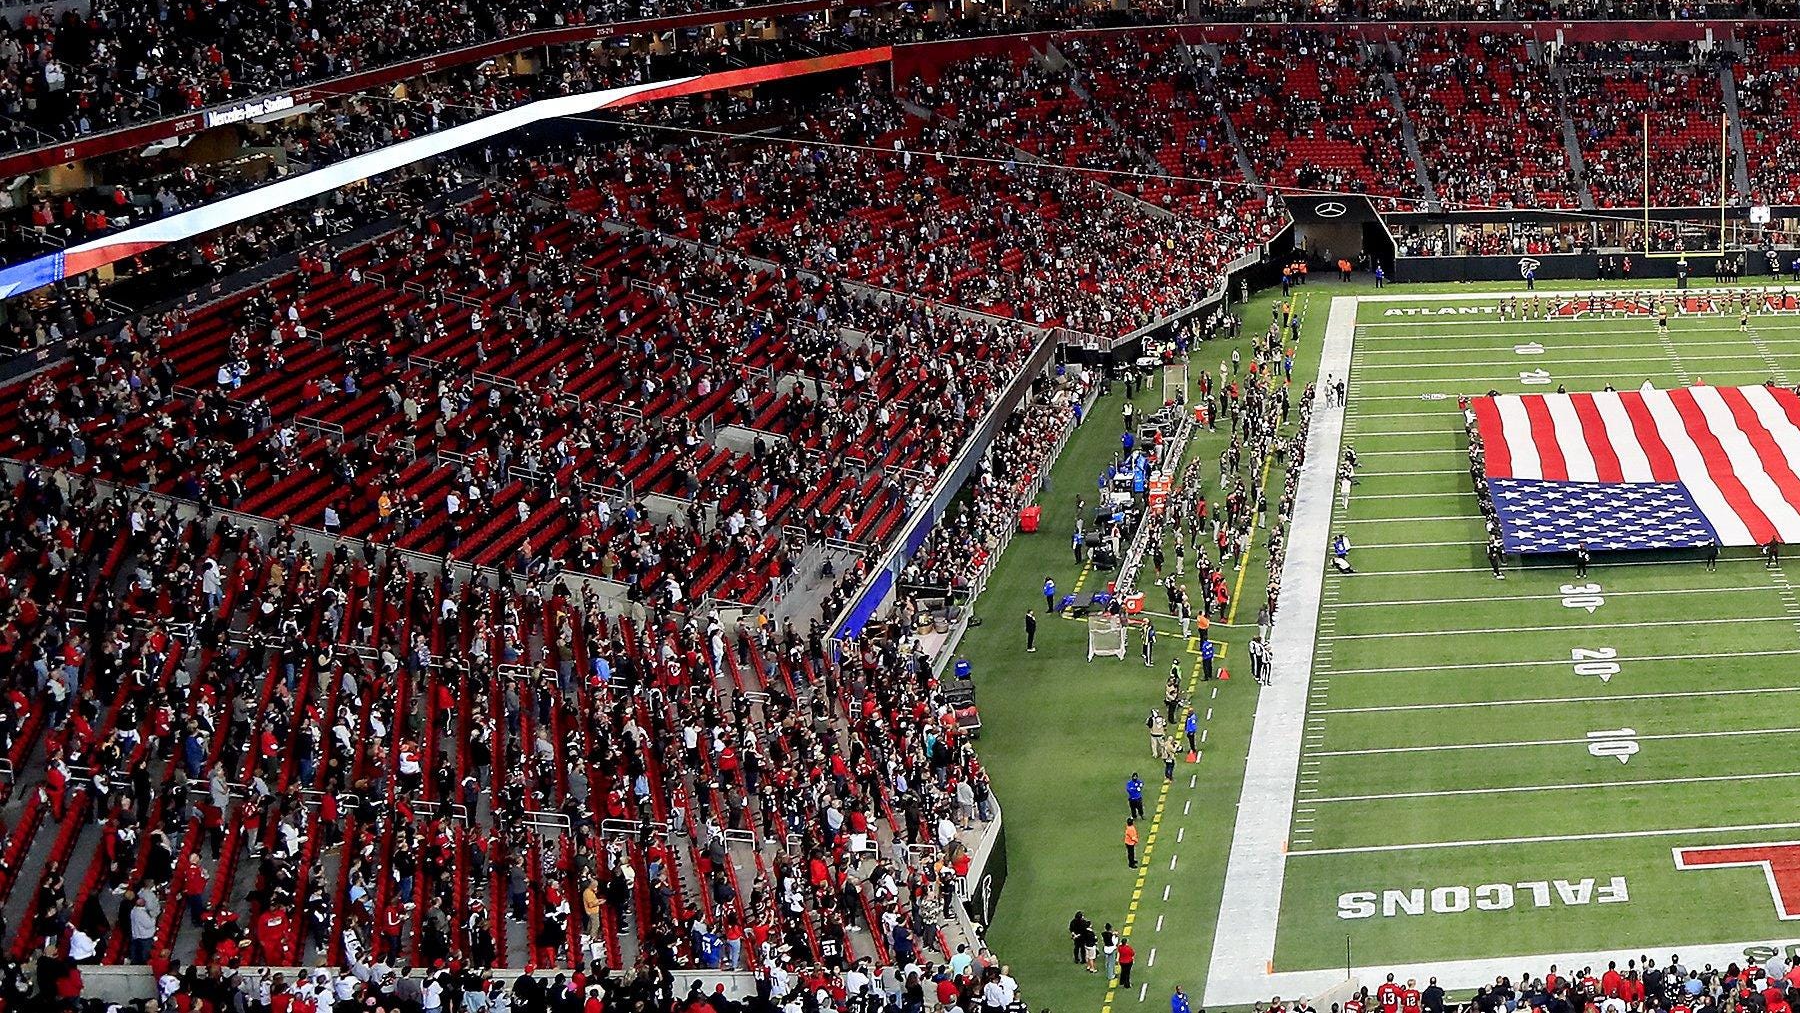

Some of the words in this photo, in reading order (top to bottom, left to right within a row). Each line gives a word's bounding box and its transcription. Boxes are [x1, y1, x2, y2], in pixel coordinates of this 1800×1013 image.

[207, 102, 263, 128] Mercedes-Benz
[264, 95, 294, 114] Stadium
[1383, 305, 1511, 317] ATLANTA
[1559, 583, 1606, 608] 30
[1571, 647, 1621, 676] 20
[1586, 727, 1640, 756] 10
[1336, 876, 1631, 920] FALCONS
[823, 944, 837, 956] 21
[1382, 992, 1396, 1006] 13
[1406, 996, 1417, 1007] 12
